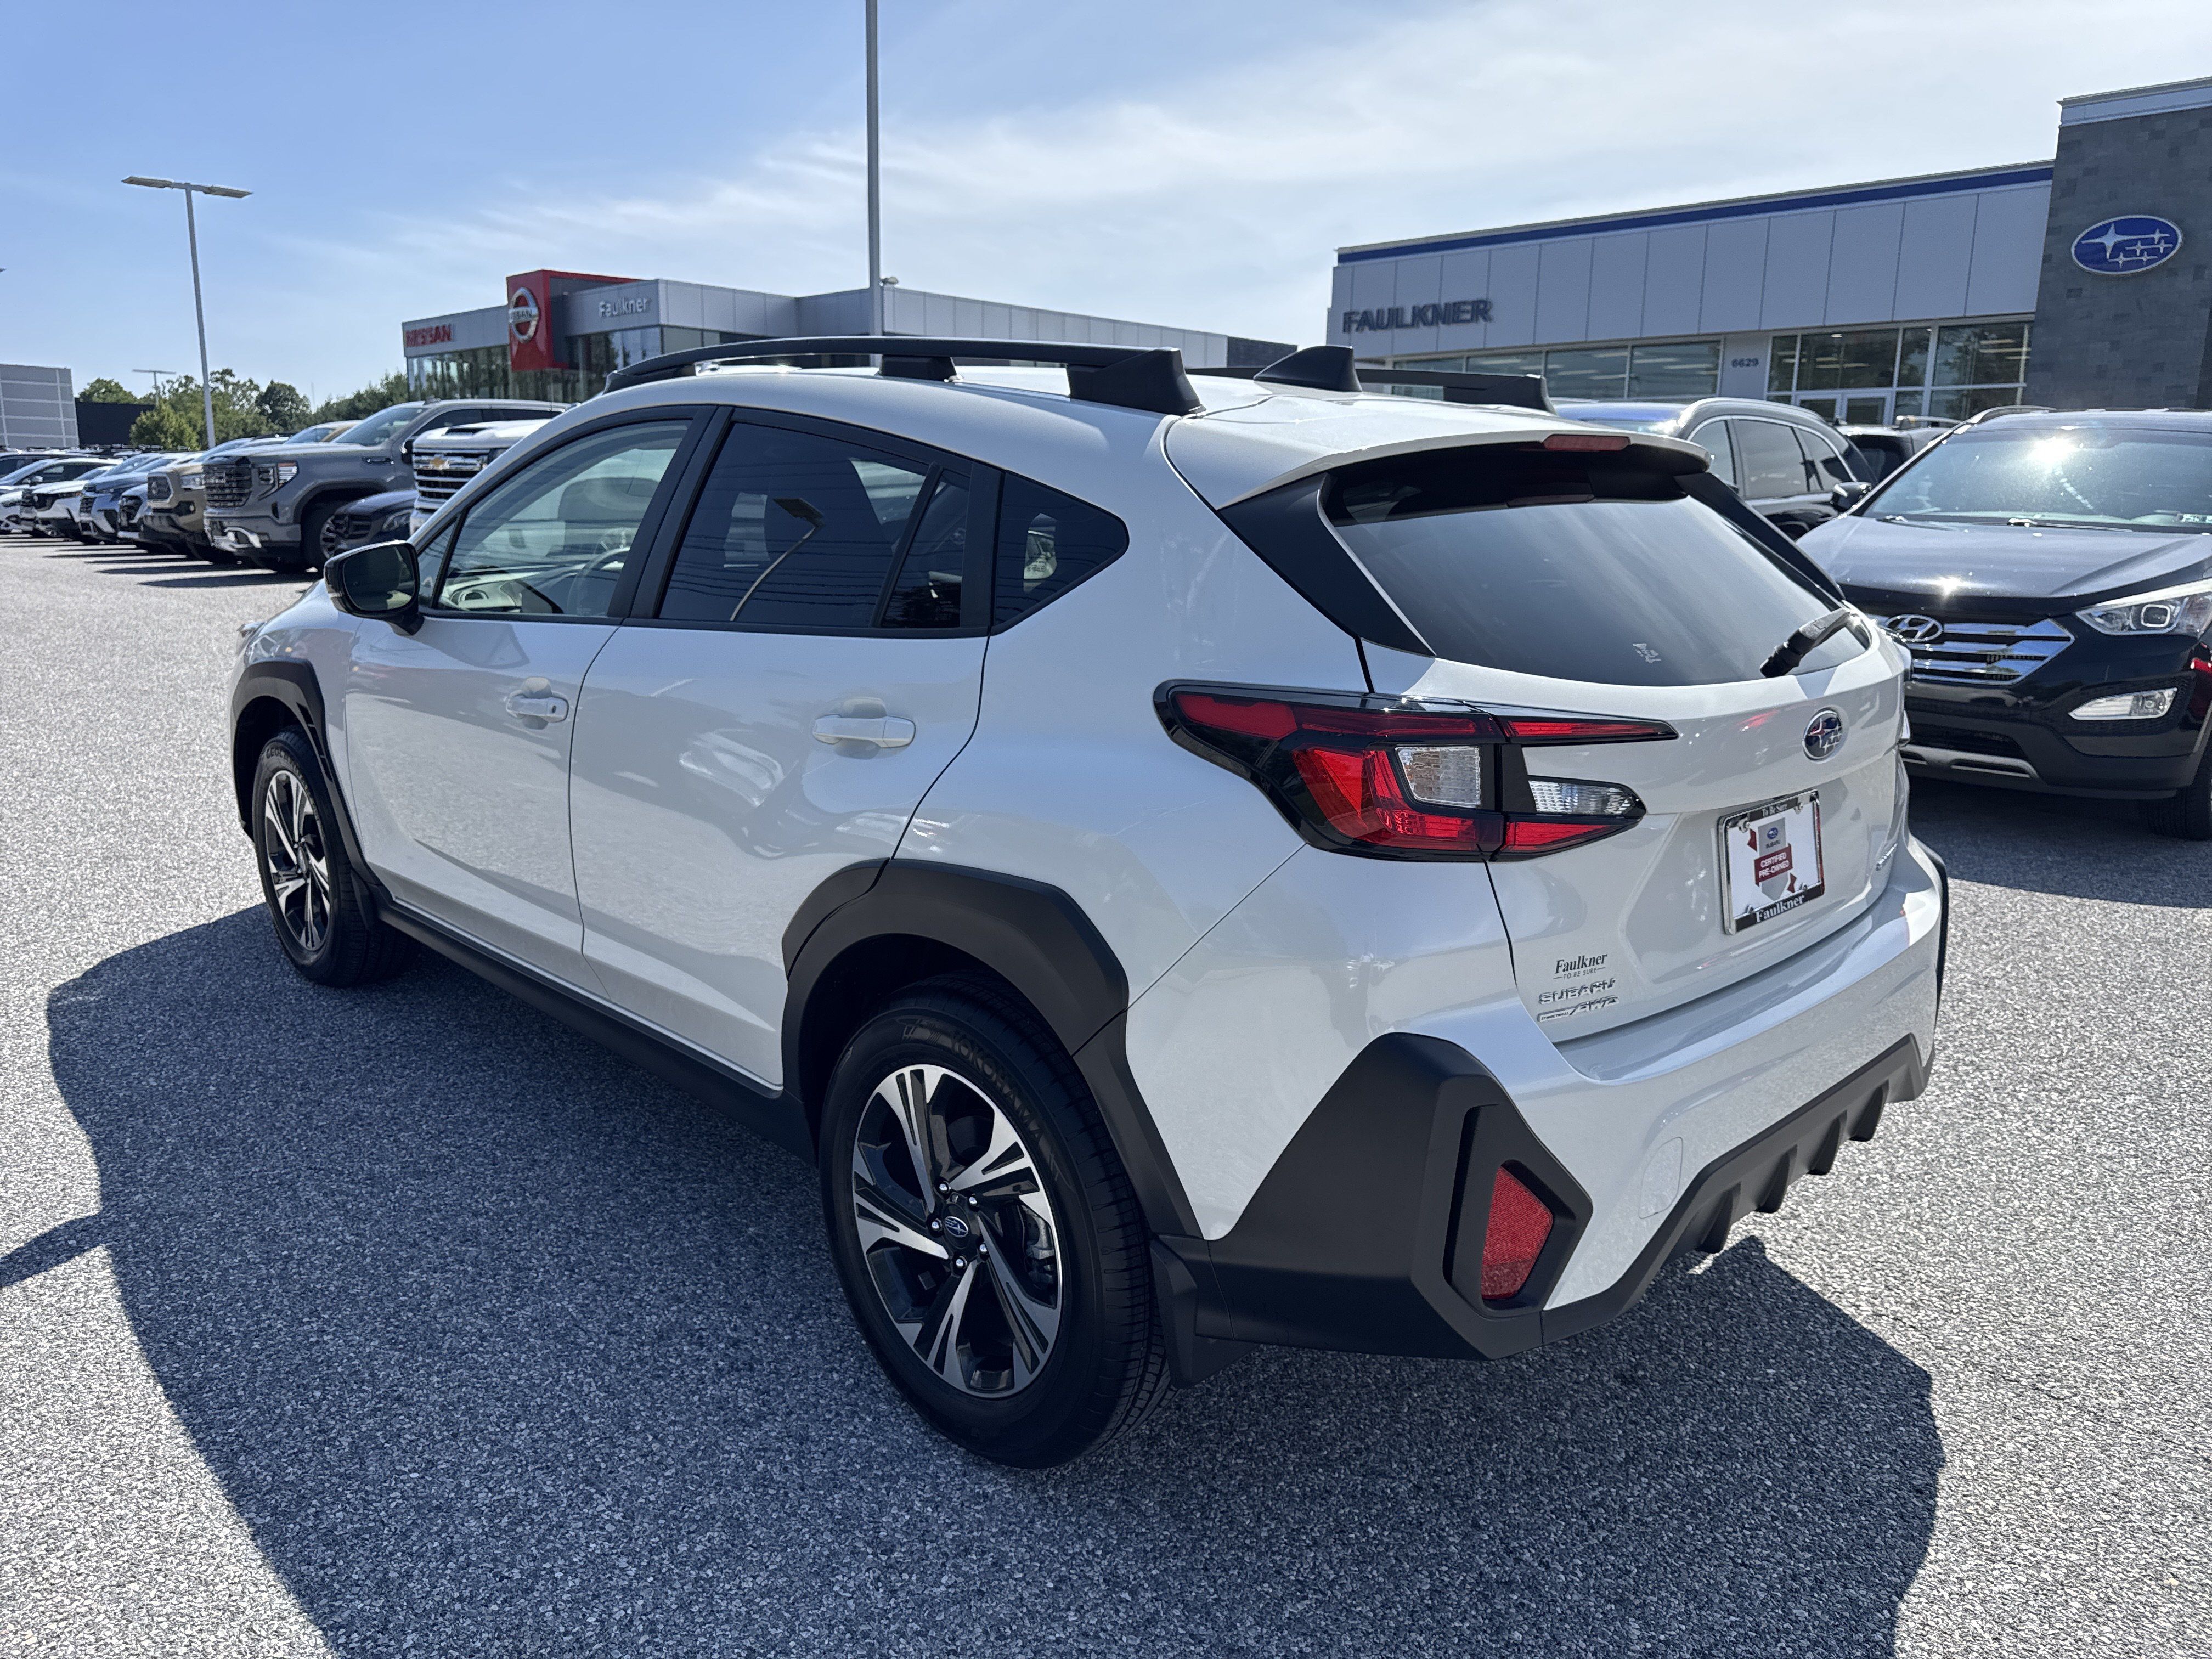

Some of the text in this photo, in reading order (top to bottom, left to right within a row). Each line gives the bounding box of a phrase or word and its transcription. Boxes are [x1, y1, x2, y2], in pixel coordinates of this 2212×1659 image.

[599, 297, 648, 318] Faulkner
[1342, 299, 1493, 333] FAULKNER
[405, 324, 452, 347] NISSAN
[1731, 357, 1759, 368] 6629
[1758, 860, 1789, 878] PRE-OWNED
[1760, 852, 1787, 868] CERTIFIED
[1756, 895, 1805, 922] Faulkner
[1555, 953, 1608, 974] Faulkner
[1583, 967, 1597, 975] SURE
[1538, 978, 1616, 1005] SUBARU
[1572, 995, 1619, 1015] AWD
[951, 1029, 1045, 1141] YOKOHAMA
